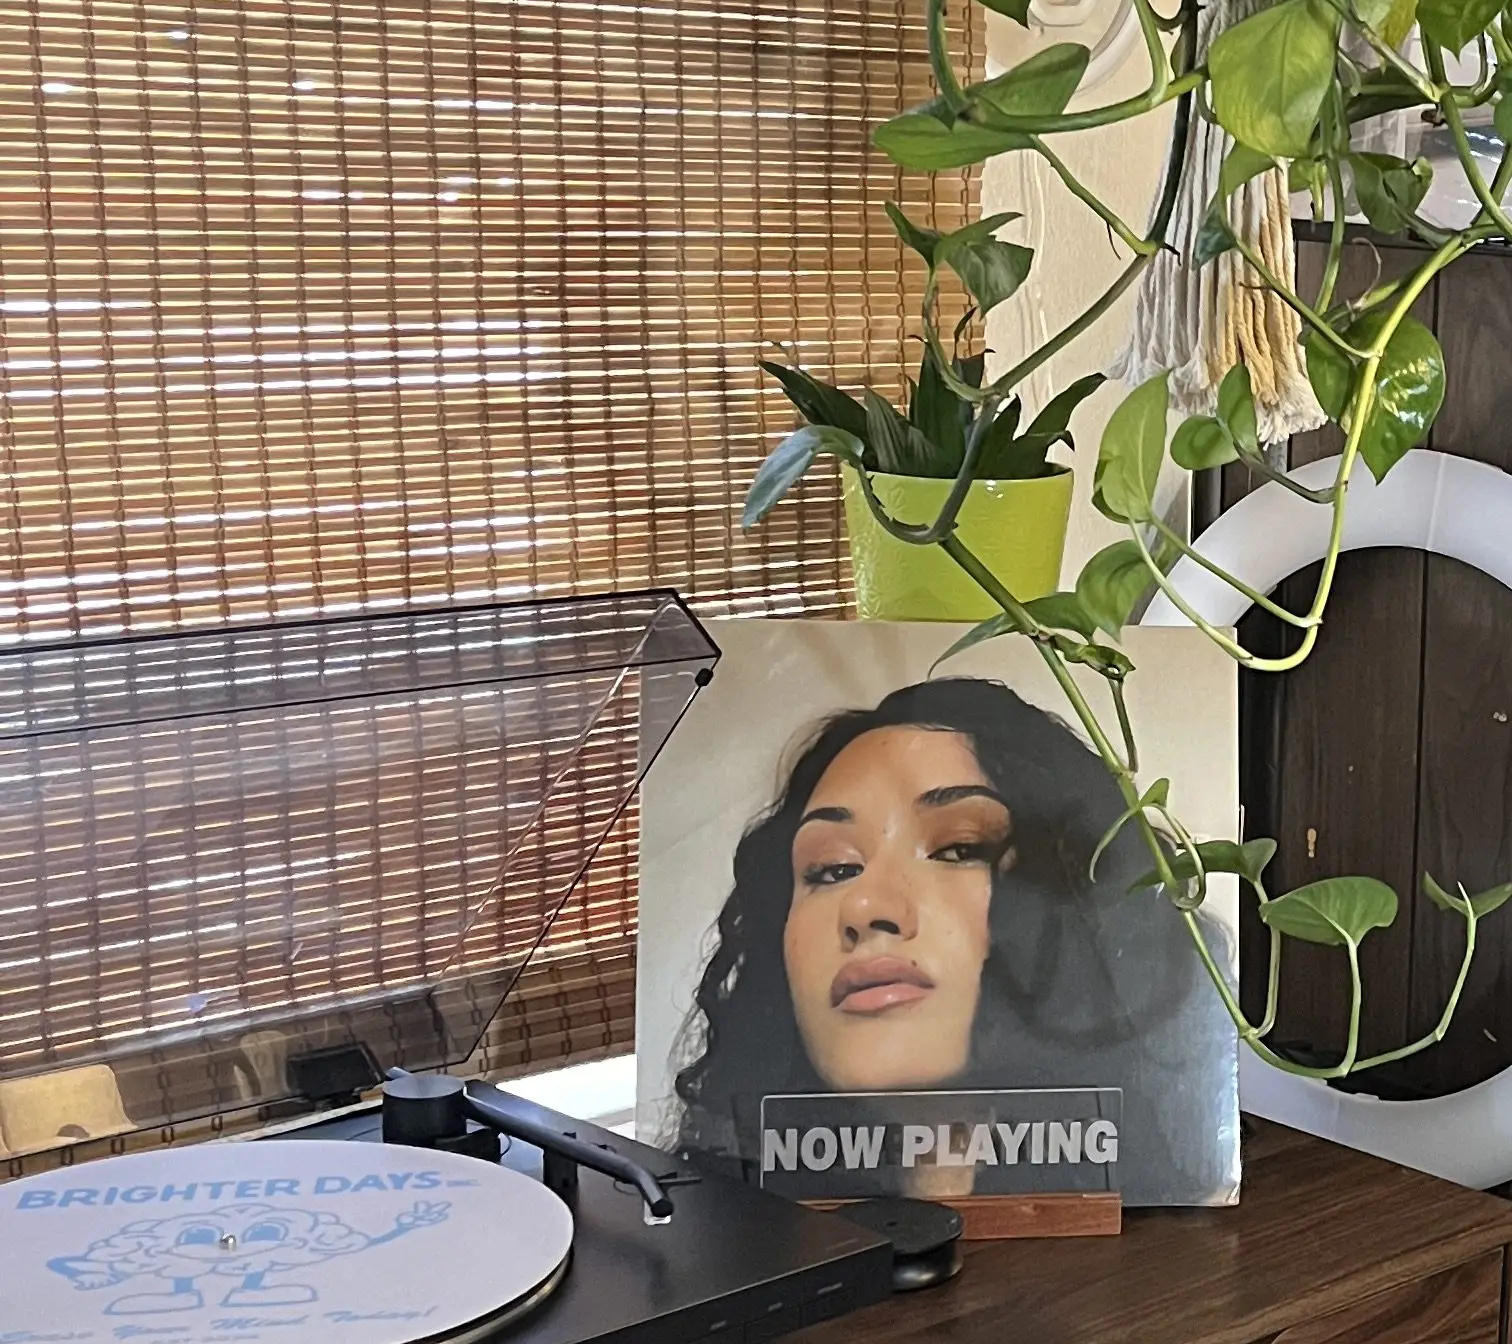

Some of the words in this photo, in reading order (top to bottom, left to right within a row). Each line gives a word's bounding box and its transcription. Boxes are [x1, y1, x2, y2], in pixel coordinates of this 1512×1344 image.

[763, 1126, 886, 1173] NOW
[902, 1120, 1119, 1168] PLAYING
[16, 1178, 300, 1209] BRIGHTER
[313, 1171, 442, 1195] DAYS
